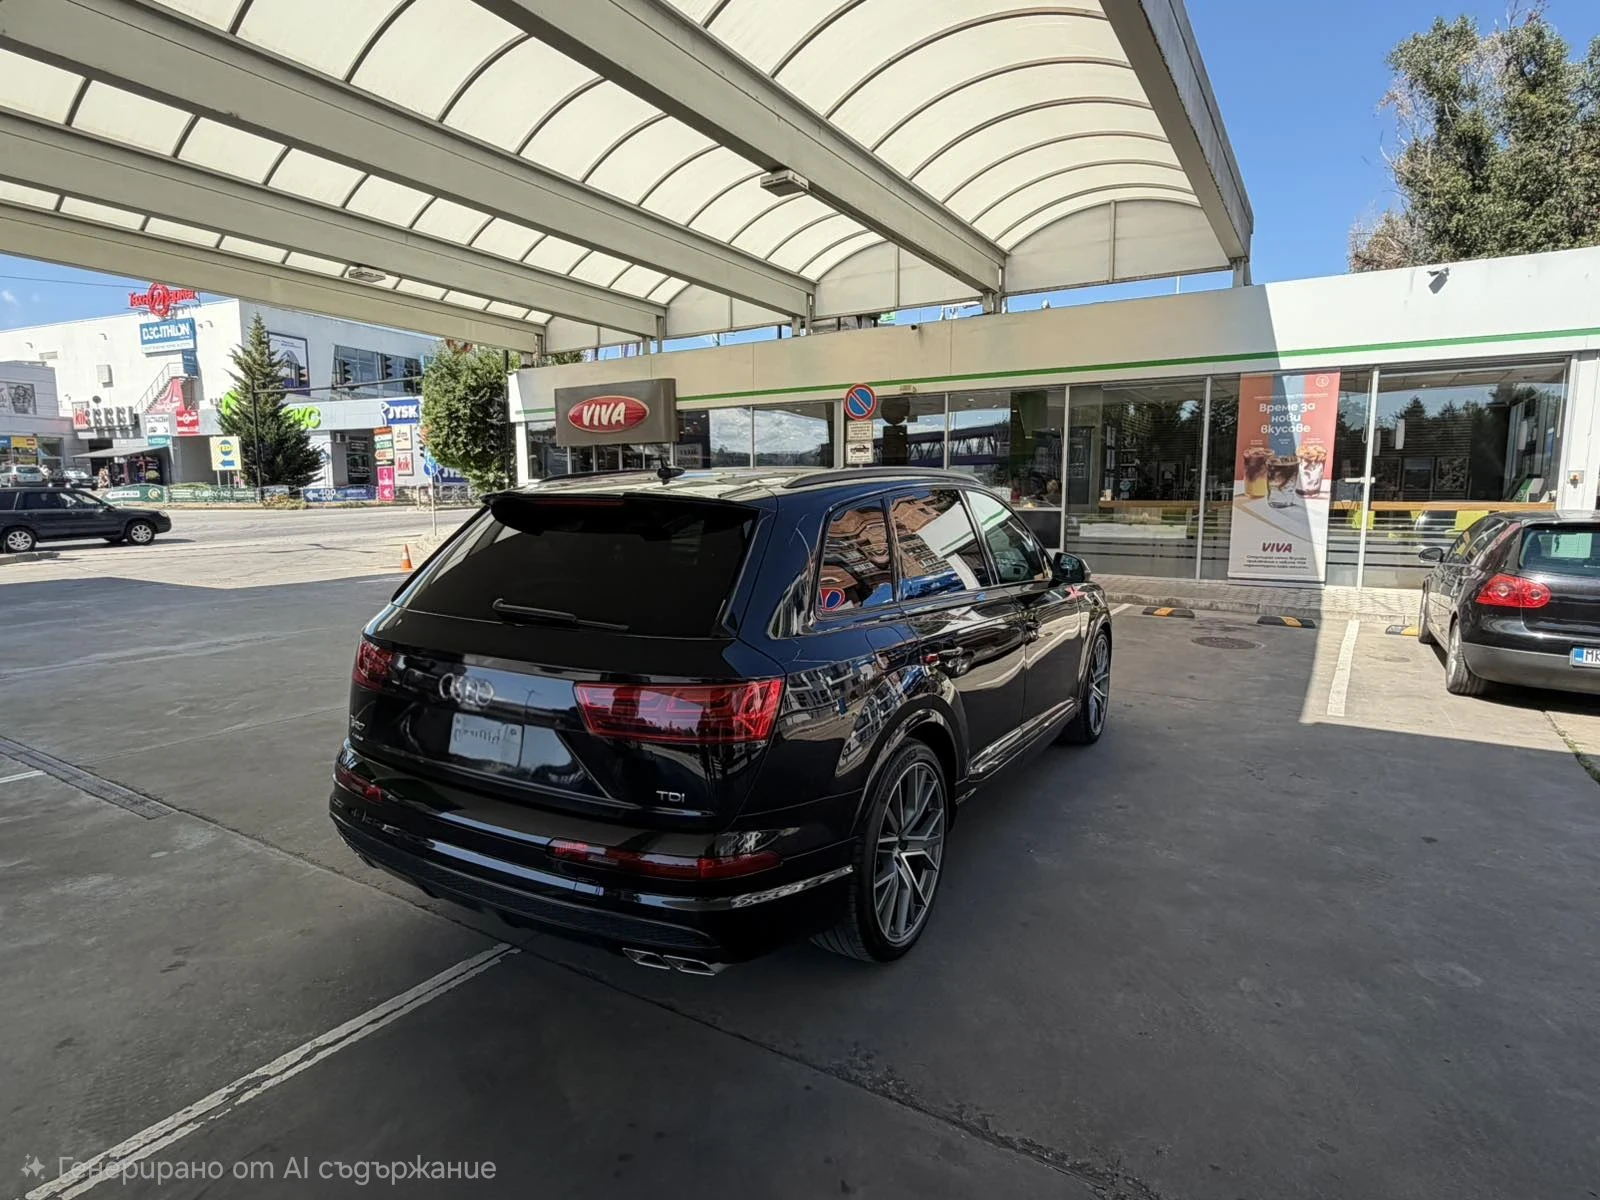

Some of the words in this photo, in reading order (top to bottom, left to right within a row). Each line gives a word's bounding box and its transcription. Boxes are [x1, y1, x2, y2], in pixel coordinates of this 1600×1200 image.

[142, 323, 190, 340] DECATHLON
[388, 405, 418, 419] JYSK
[582, 402, 625, 426] VIVA
[1259, 402, 1298, 414] Време
[1299, 402, 1316, 412] за
[1271, 412, 1301, 423] нови
[1260, 423, 1311, 436] вкусове
[1262, 542, 1293, 553] VIVA
[656, 790, 685, 803] TDI
